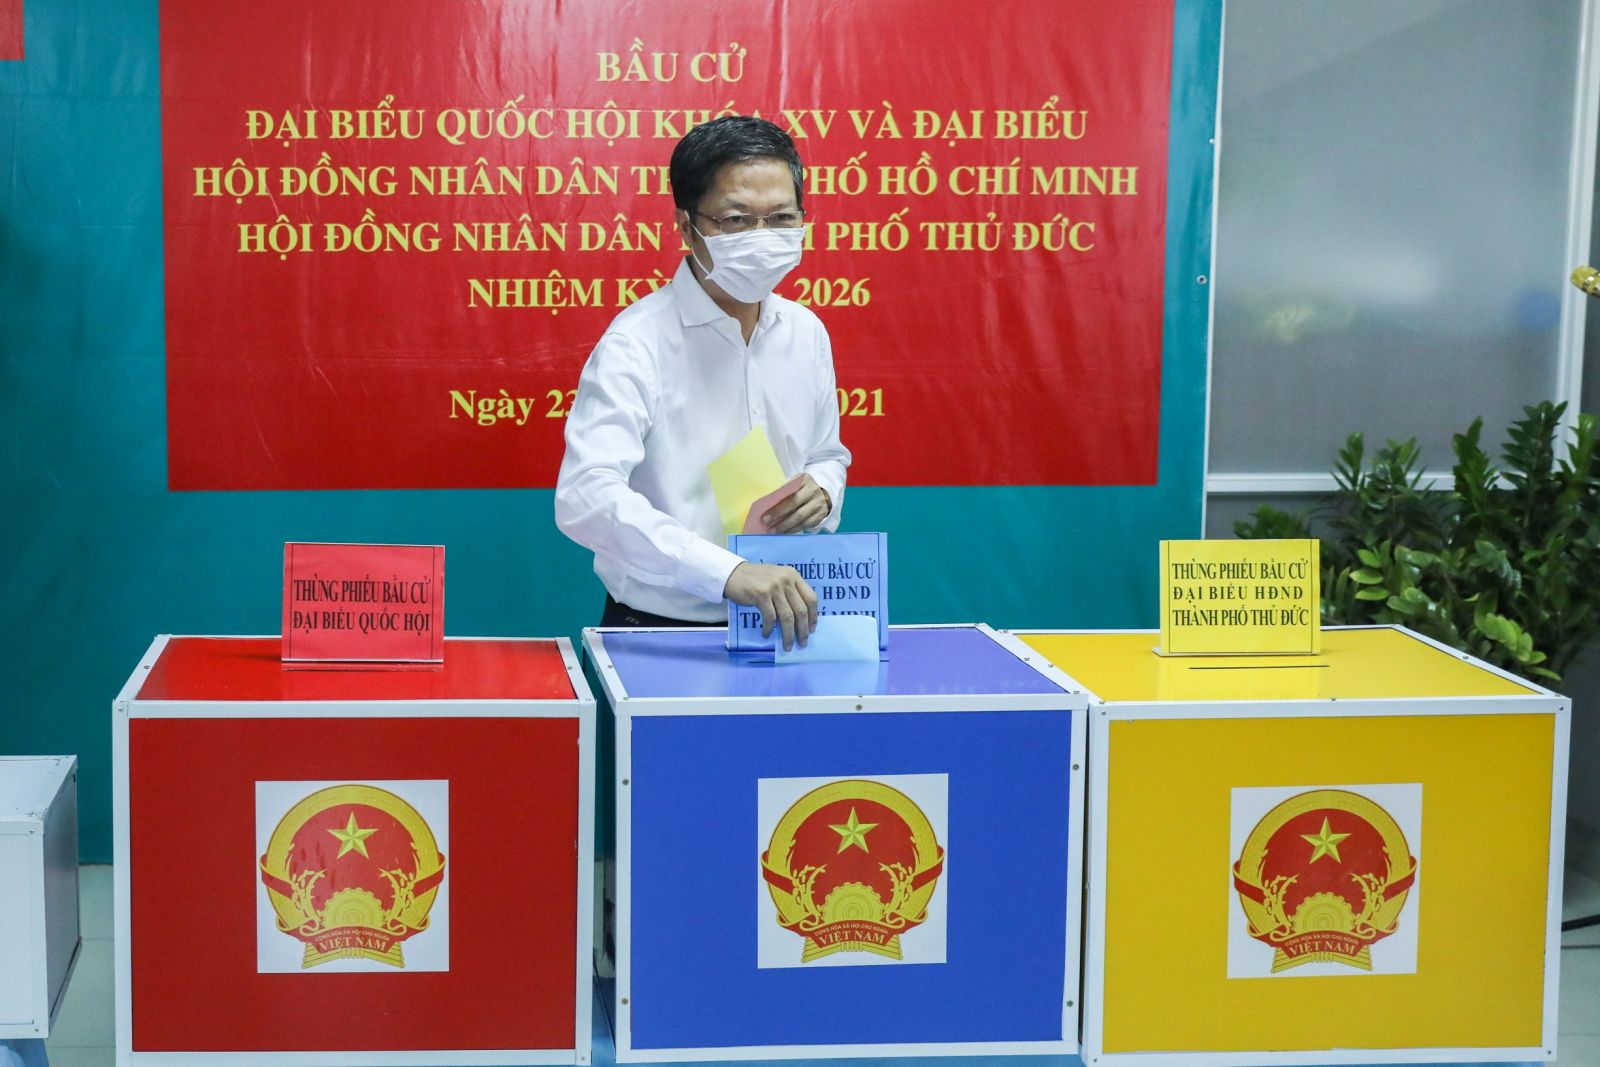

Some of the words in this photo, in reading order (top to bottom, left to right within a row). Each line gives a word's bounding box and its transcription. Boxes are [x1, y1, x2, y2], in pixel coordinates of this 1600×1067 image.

[596, 37, 678, 82] BẦU
[691, 42, 747, 82] CỬ
[246, 109, 318, 147] ĐẠI
[329, 94, 425, 140] BIỂU
[436, 94, 554, 145] QUỐC
[566, 102, 640, 147] HỘI
[652, 100, 761, 138] KH
[782, 109, 836, 139] XV
[847, 100, 902, 139] VÀ
[913, 109, 985, 148] ĐẠI
[995, 95, 1088, 140] BIỂU
[193, 157, 271, 204] HỘI
[279, 152, 397, 196] ĐỒNG
[409, 156, 525, 196] NHÂN
[535, 156, 619, 196] DÂN
[803, 151, 868, 196] HỐ
[880, 151, 937, 197] HỒ
[949, 156, 1021, 196] CHÍ
[1032, 166, 1138, 196] MINH
[237, 215, 313, 261] HỘI
[324, 208, 441, 252] ĐỒNG
[452, 213, 568, 252] NHÂN
[578, 213, 662, 252] DÂN
[827, 207, 910, 252] PHỐ
[920, 210, 1002, 252] THỦ
[1013, 212, 1095, 252] ĐỨC
[467, 270, 605, 315] NHIỆM
[793, 277, 871, 307] 2026
[449, 389, 536, 426] Ngày
[836, 387, 886, 417] 021
[1172, 558, 1217, 580] THÙNG
[1219, 558, 1257, 580] PHIẾU
[293, 573, 339, 603] THÙNG
[341, 574, 381, 604] PHIẾU
[823, 585, 871, 600] HĐND
[1173, 586, 1203, 604] ĐẠI
[1255, 586, 1304, 600] HĐND
[293, 611, 319, 634] ĐẠI
[358, 607, 400, 635] QUỐC
[403, 611, 431, 636] HỘI
[1172, 604, 1219, 626] THÀNH
[1221, 604, 1249, 626] PHỐ
[1280, 603, 1310, 626] ĐỨC
[355, 936, 387, 951] NAM
[854, 930, 886, 944] NAM
[1324, 940, 1357, 955] NAM
